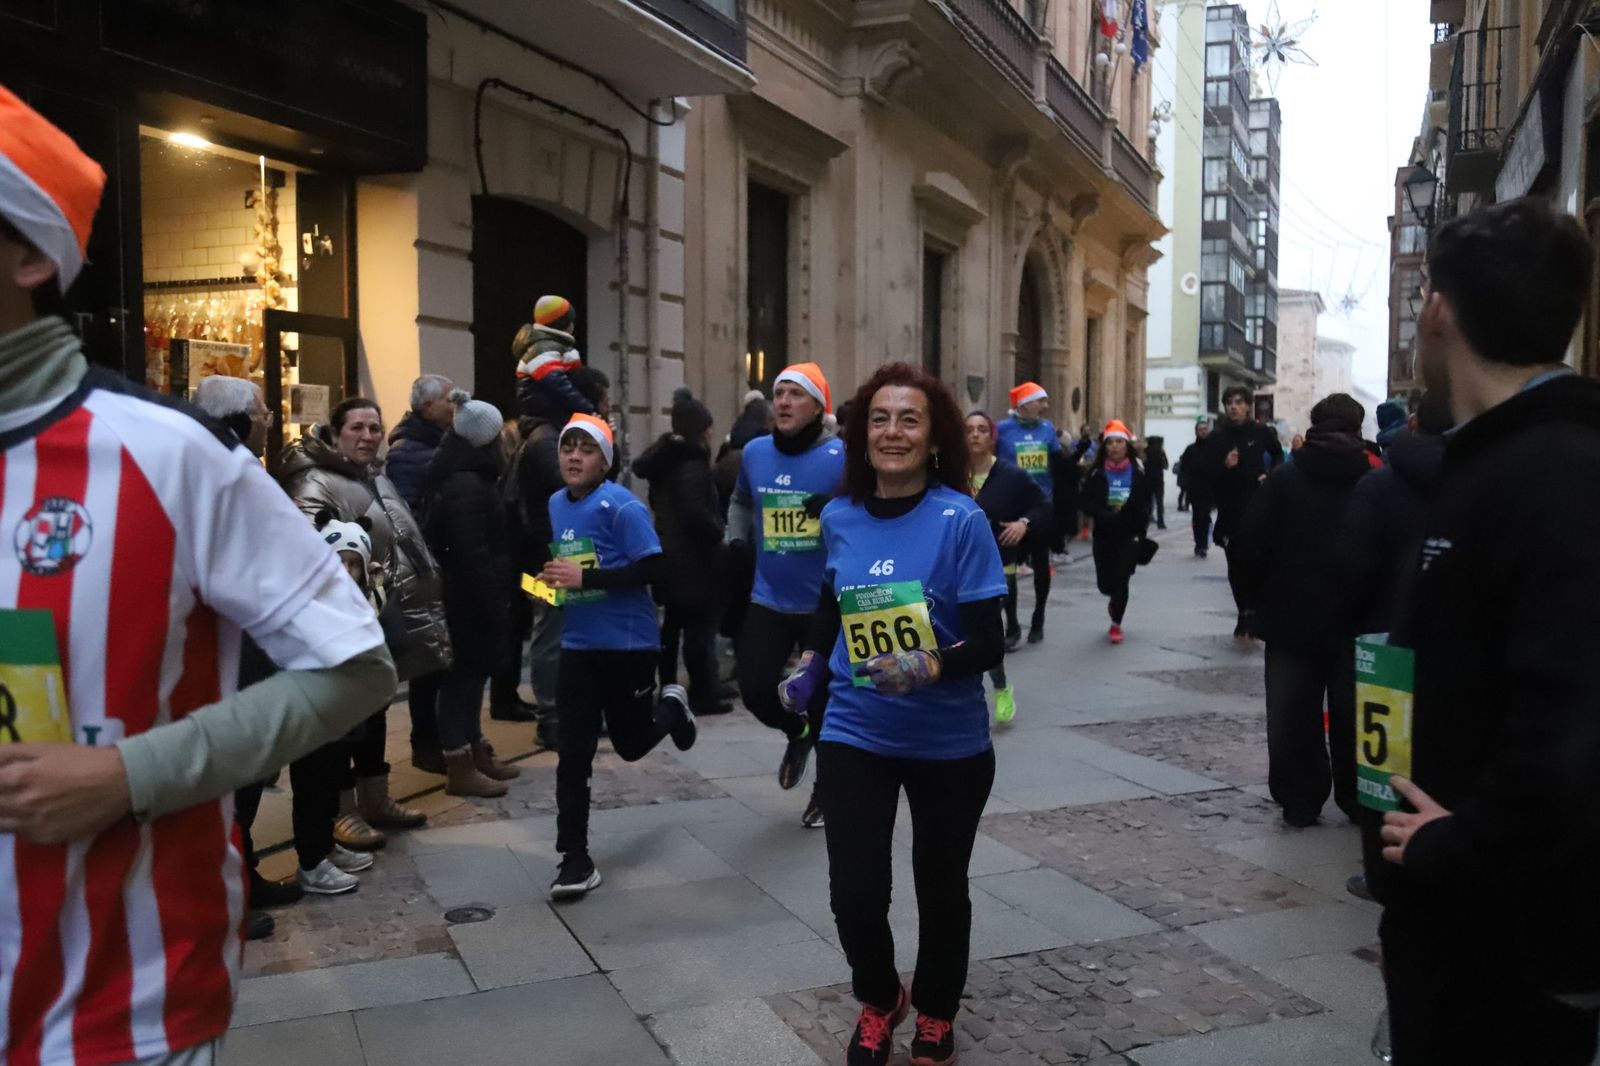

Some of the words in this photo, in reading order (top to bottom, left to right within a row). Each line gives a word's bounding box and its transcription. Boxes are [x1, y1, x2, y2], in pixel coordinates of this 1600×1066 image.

[774, 474, 792, 486] 46
[771, 510, 808, 533] 1112
[561, 529, 575, 541] 46
[869, 559, 895, 576] 46
[849, 615, 921, 660] 566
